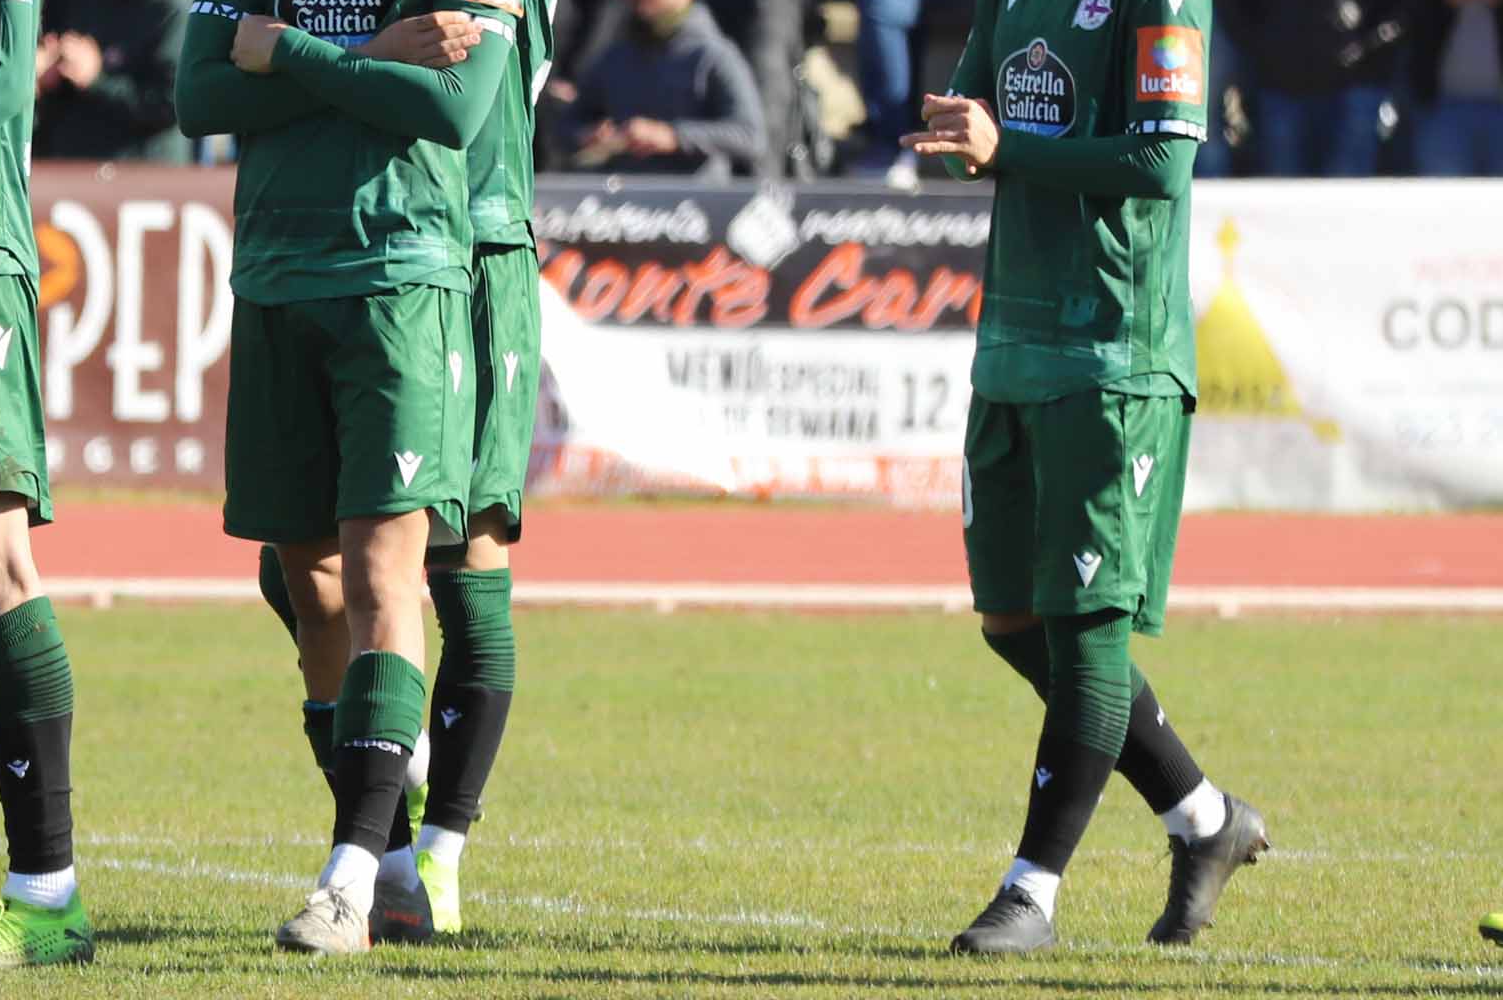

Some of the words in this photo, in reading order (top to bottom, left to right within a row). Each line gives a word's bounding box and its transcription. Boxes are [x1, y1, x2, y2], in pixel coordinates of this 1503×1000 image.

[296, 5, 377, 34] Galicia
[1003, 66, 1066, 97] Estrella
[1005, 93, 1061, 123] Galicia
